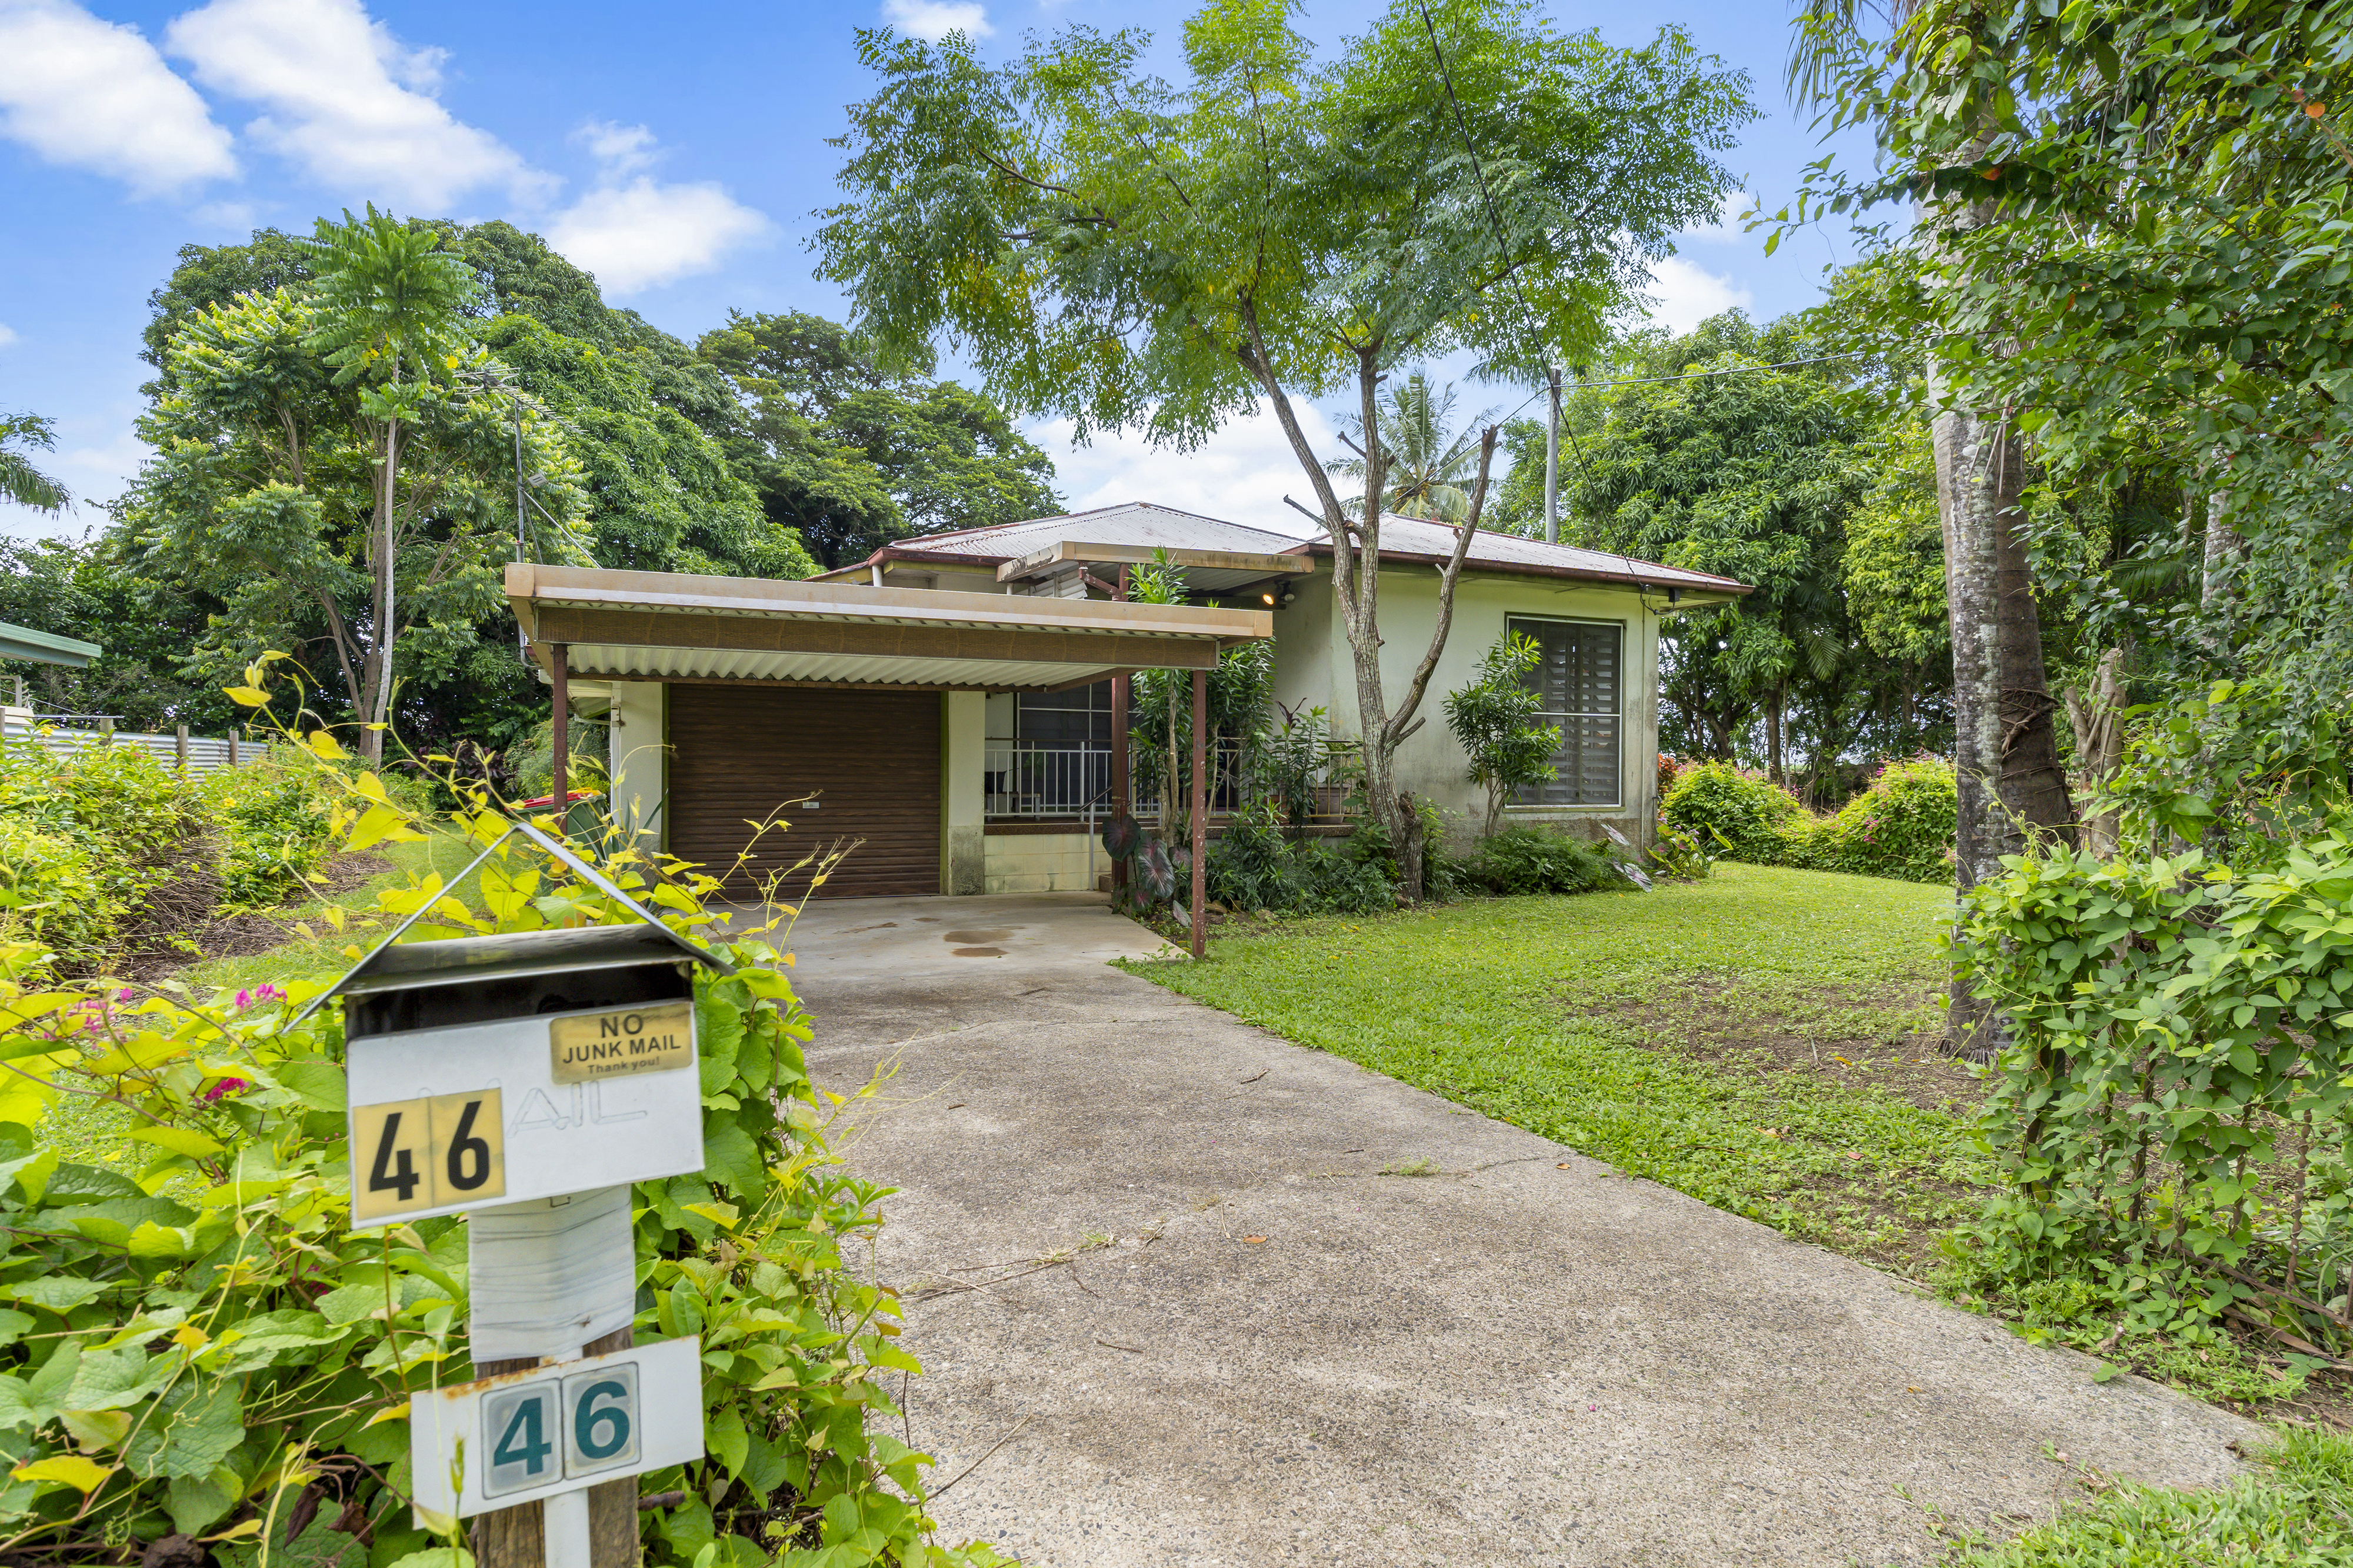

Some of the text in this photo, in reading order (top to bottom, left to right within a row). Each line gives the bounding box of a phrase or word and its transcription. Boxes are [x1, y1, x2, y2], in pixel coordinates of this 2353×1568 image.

[600, 1013, 645, 1038] NO
[562, 1034, 681, 1064] JUNK MAIL
[588, 1056, 661, 1074] Thank you!
[417, 1077, 648, 1139] AIL
[368, 1100, 491, 1202] 46
[493, 1380, 631, 1476] 46
